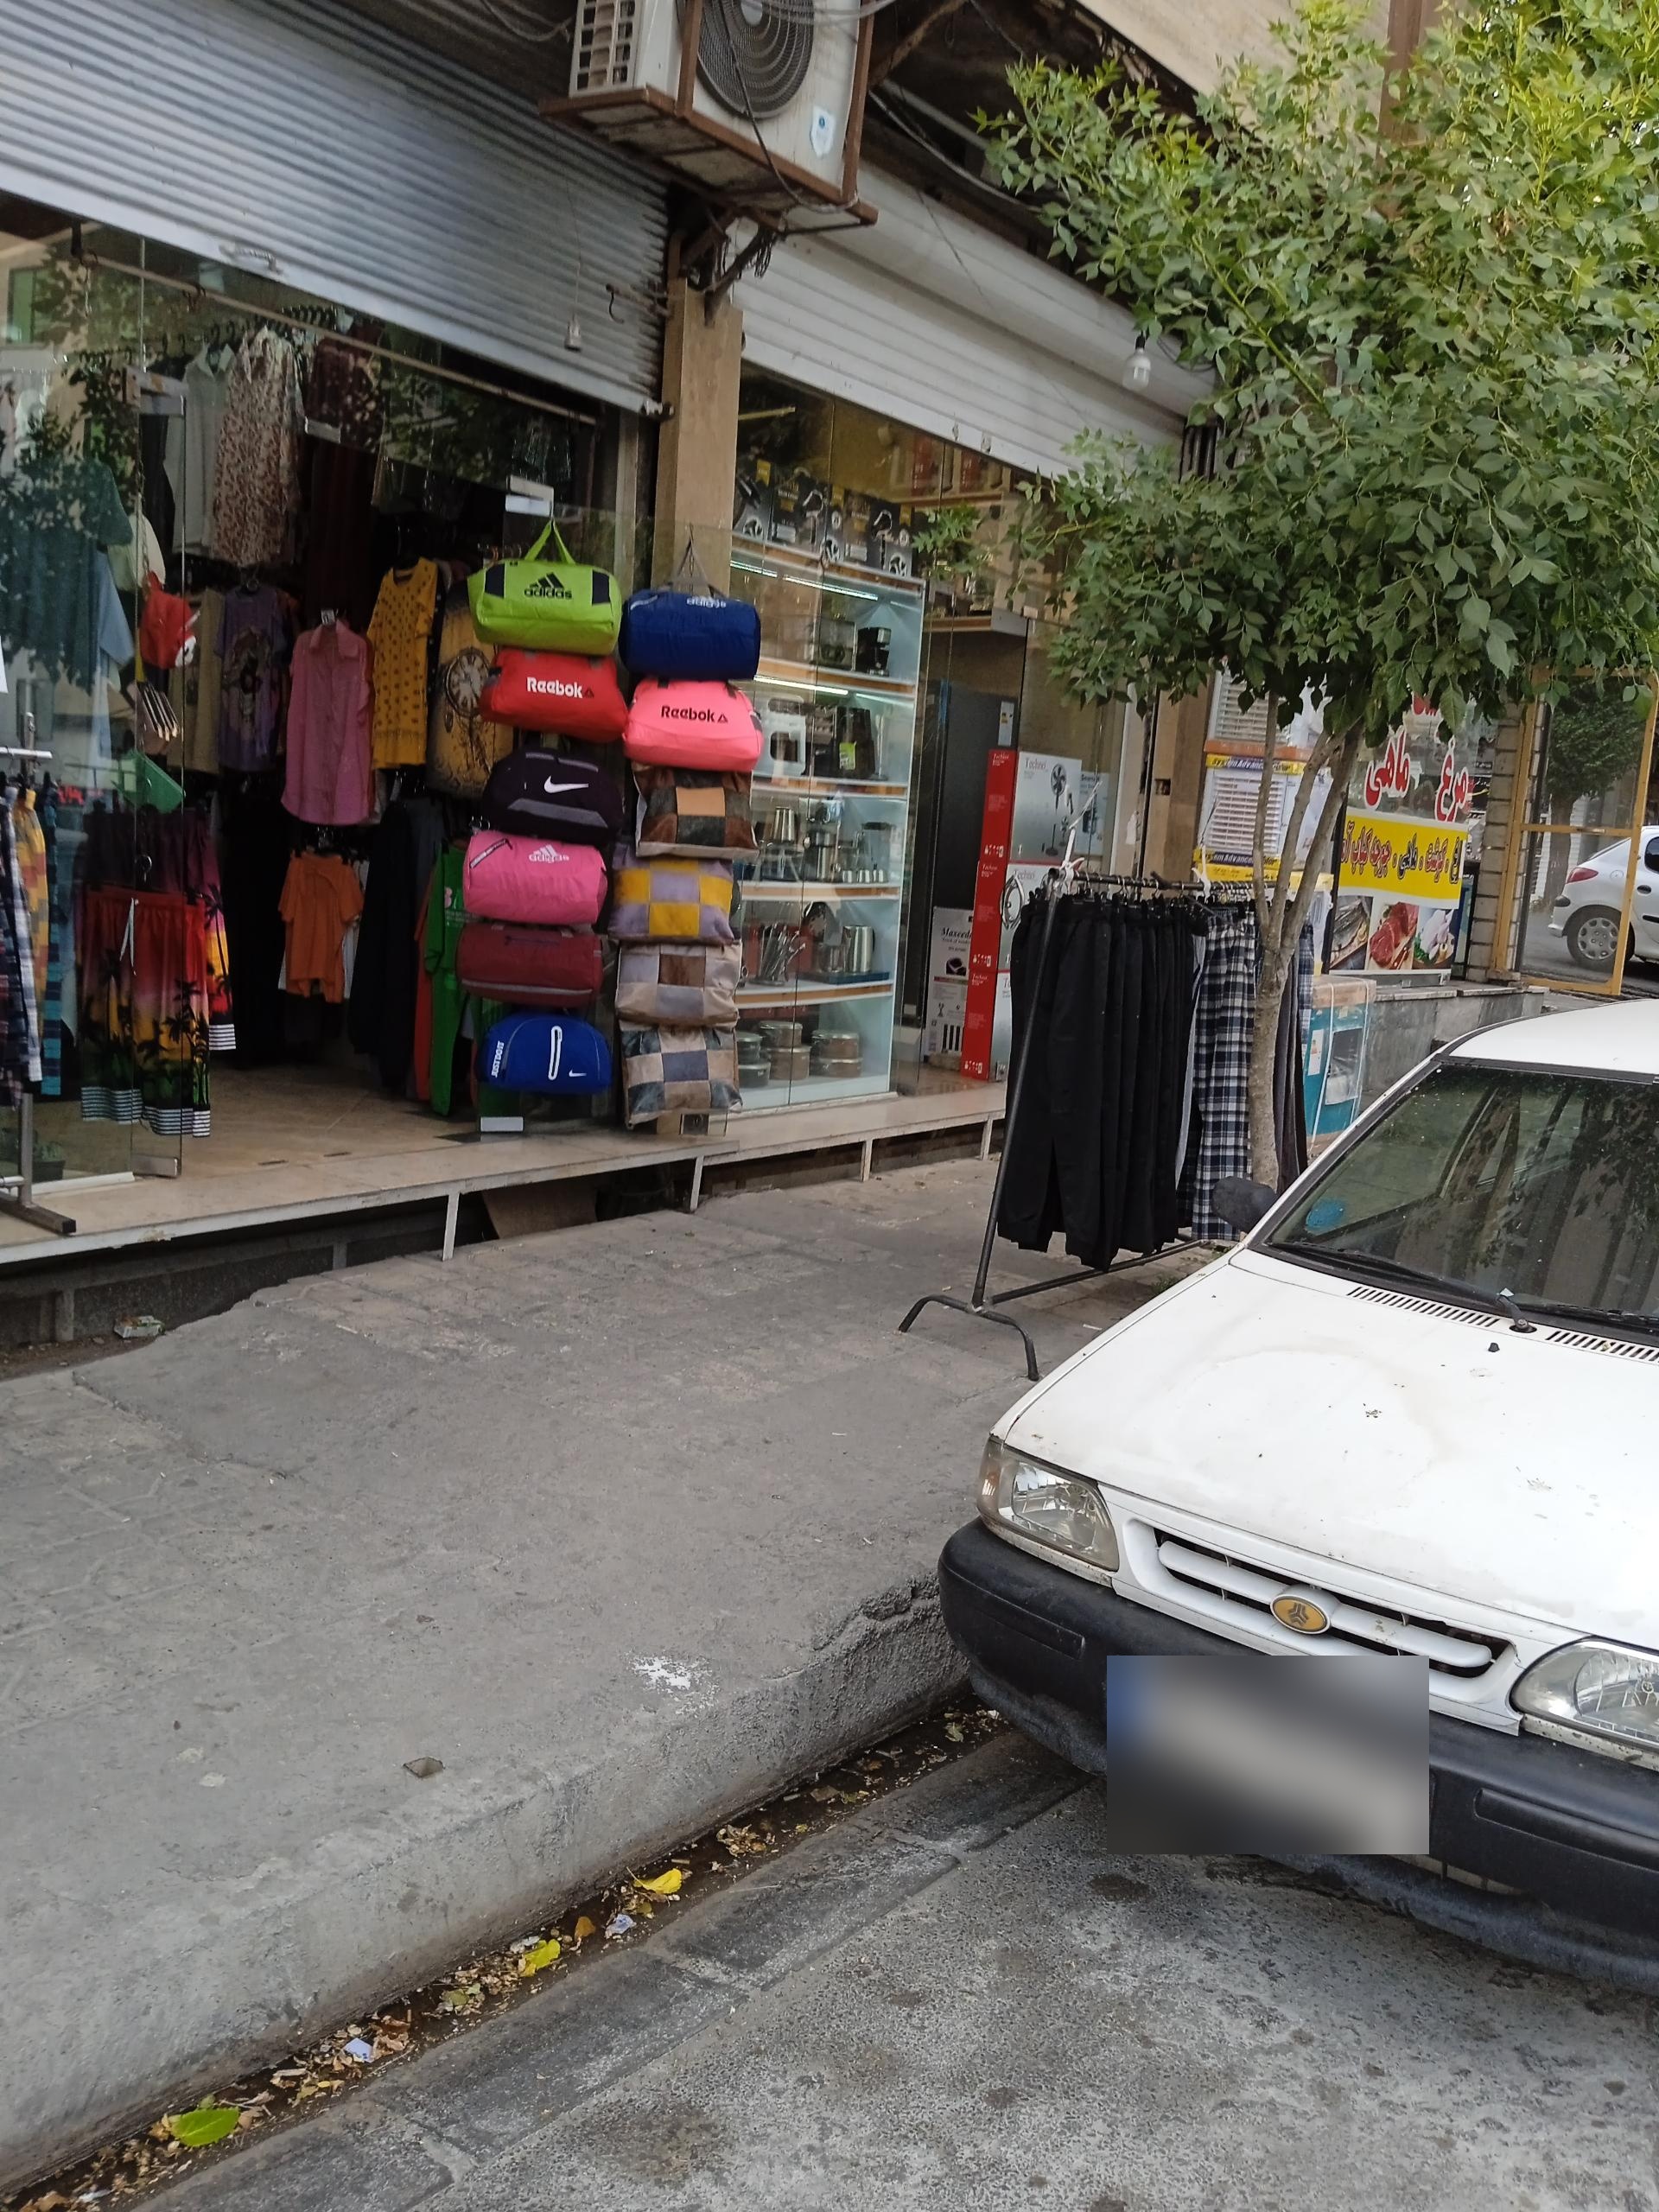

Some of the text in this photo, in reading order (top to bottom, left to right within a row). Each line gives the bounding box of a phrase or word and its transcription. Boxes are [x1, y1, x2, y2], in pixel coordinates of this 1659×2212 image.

[524, 587, 572, 600] adidas
[526, 676, 583, 699] Reebok
[661, 705, 715, 723] Reebok
[1364, 724, 1411, 811] ماهی
[1435, 734, 1469, 823] مرغ
[1397, 832, 1419, 880] ماهی
